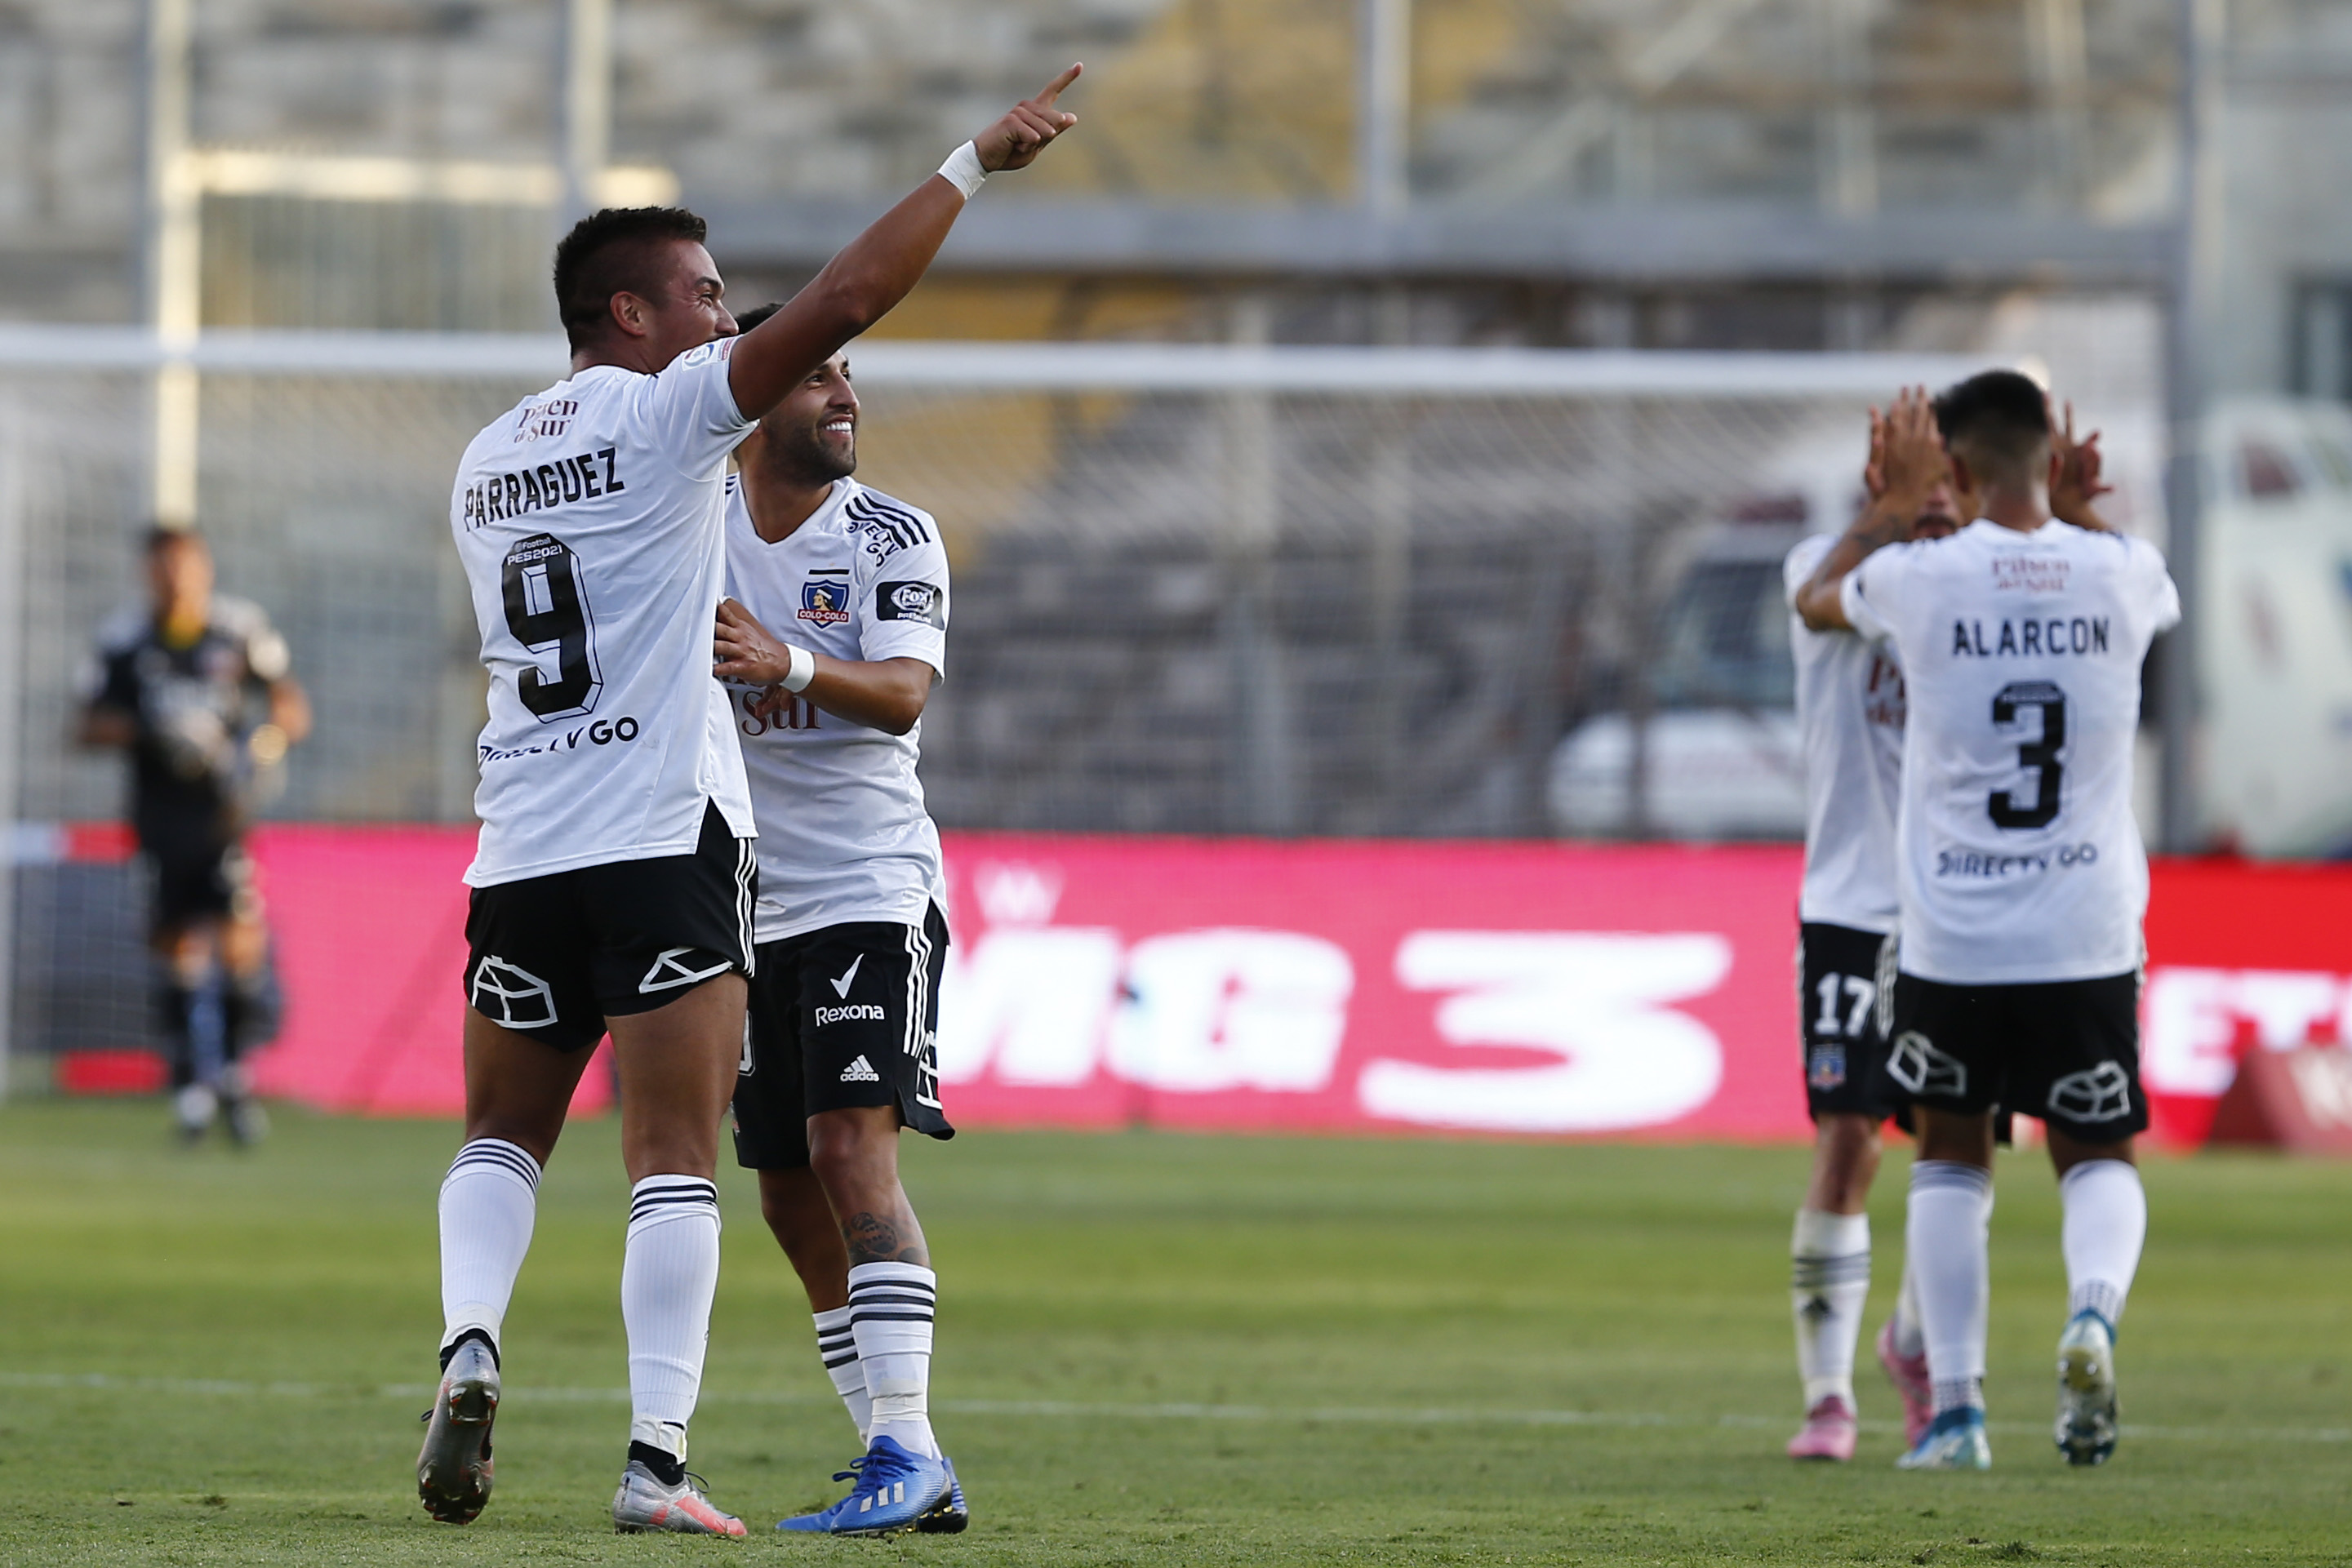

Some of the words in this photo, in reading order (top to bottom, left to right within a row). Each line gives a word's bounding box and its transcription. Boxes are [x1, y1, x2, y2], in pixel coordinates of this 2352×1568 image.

[464, 447, 625, 532] PARRAGUEZ
[507, 544, 562, 566] PES2021
[901, 589, 929, 603] FOX
[501, 532, 604, 724] 9
[799, 611, 847, 621] COLO-COLO
[1954, 618, 2109, 655] ALARCON
[589, 717, 638, 746] GO
[1988, 679, 2074, 832] 3
[2058, 842, 2099, 869] GO
[815, 1004, 885, 1027] Rexona
[1813, 971, 1877, 1037] 17
[1355, 928, 1736, 1134] 3
[839, 1071, 880, 1082] adidas
